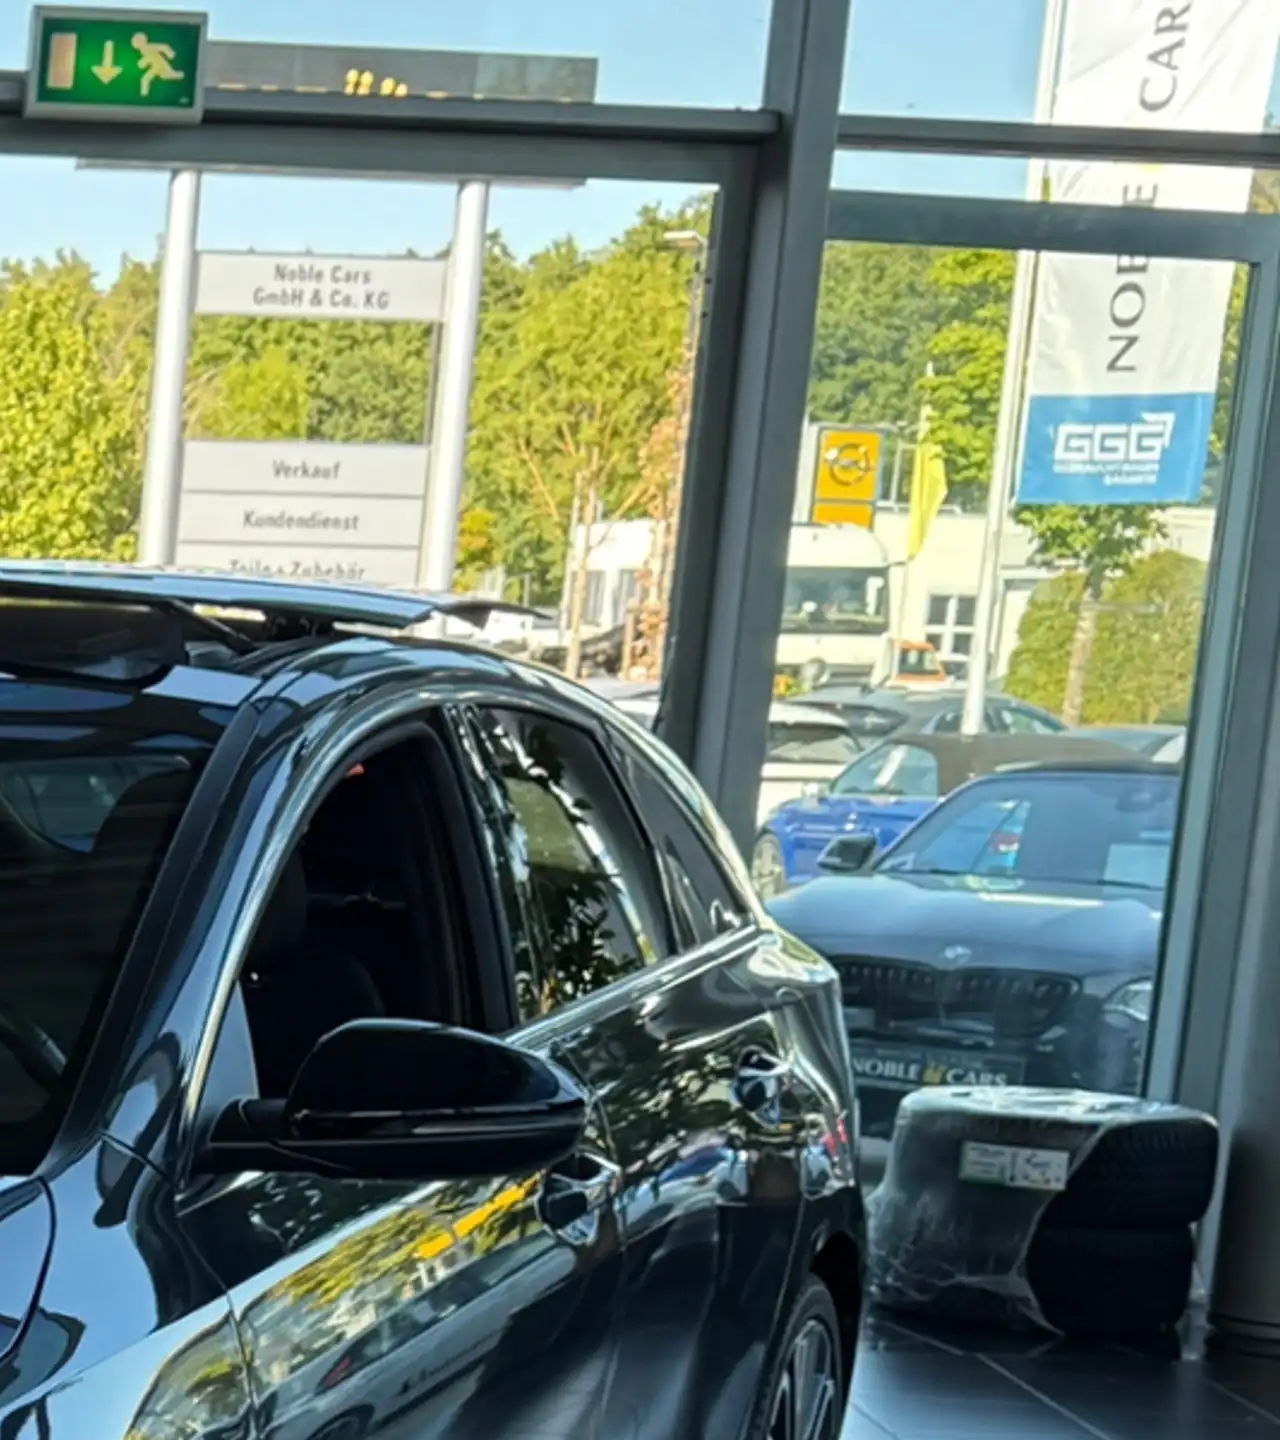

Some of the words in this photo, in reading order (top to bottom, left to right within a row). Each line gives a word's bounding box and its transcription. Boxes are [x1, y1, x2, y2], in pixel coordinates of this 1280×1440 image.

[273, 263, 324, 284] Noble
[330, 265, 372, 285] Cars
[252, 286, 305, 308] GmbH
[309, 288, 323, 308] &
[329, 289, 359, 309] Co.
[362, 290, 391, 310] KG
[272, 459, 341, 480] Verkauf
[243, 509, 360, 531] Kundendienst
[852, 1056, 921, 1081] NOBLE
